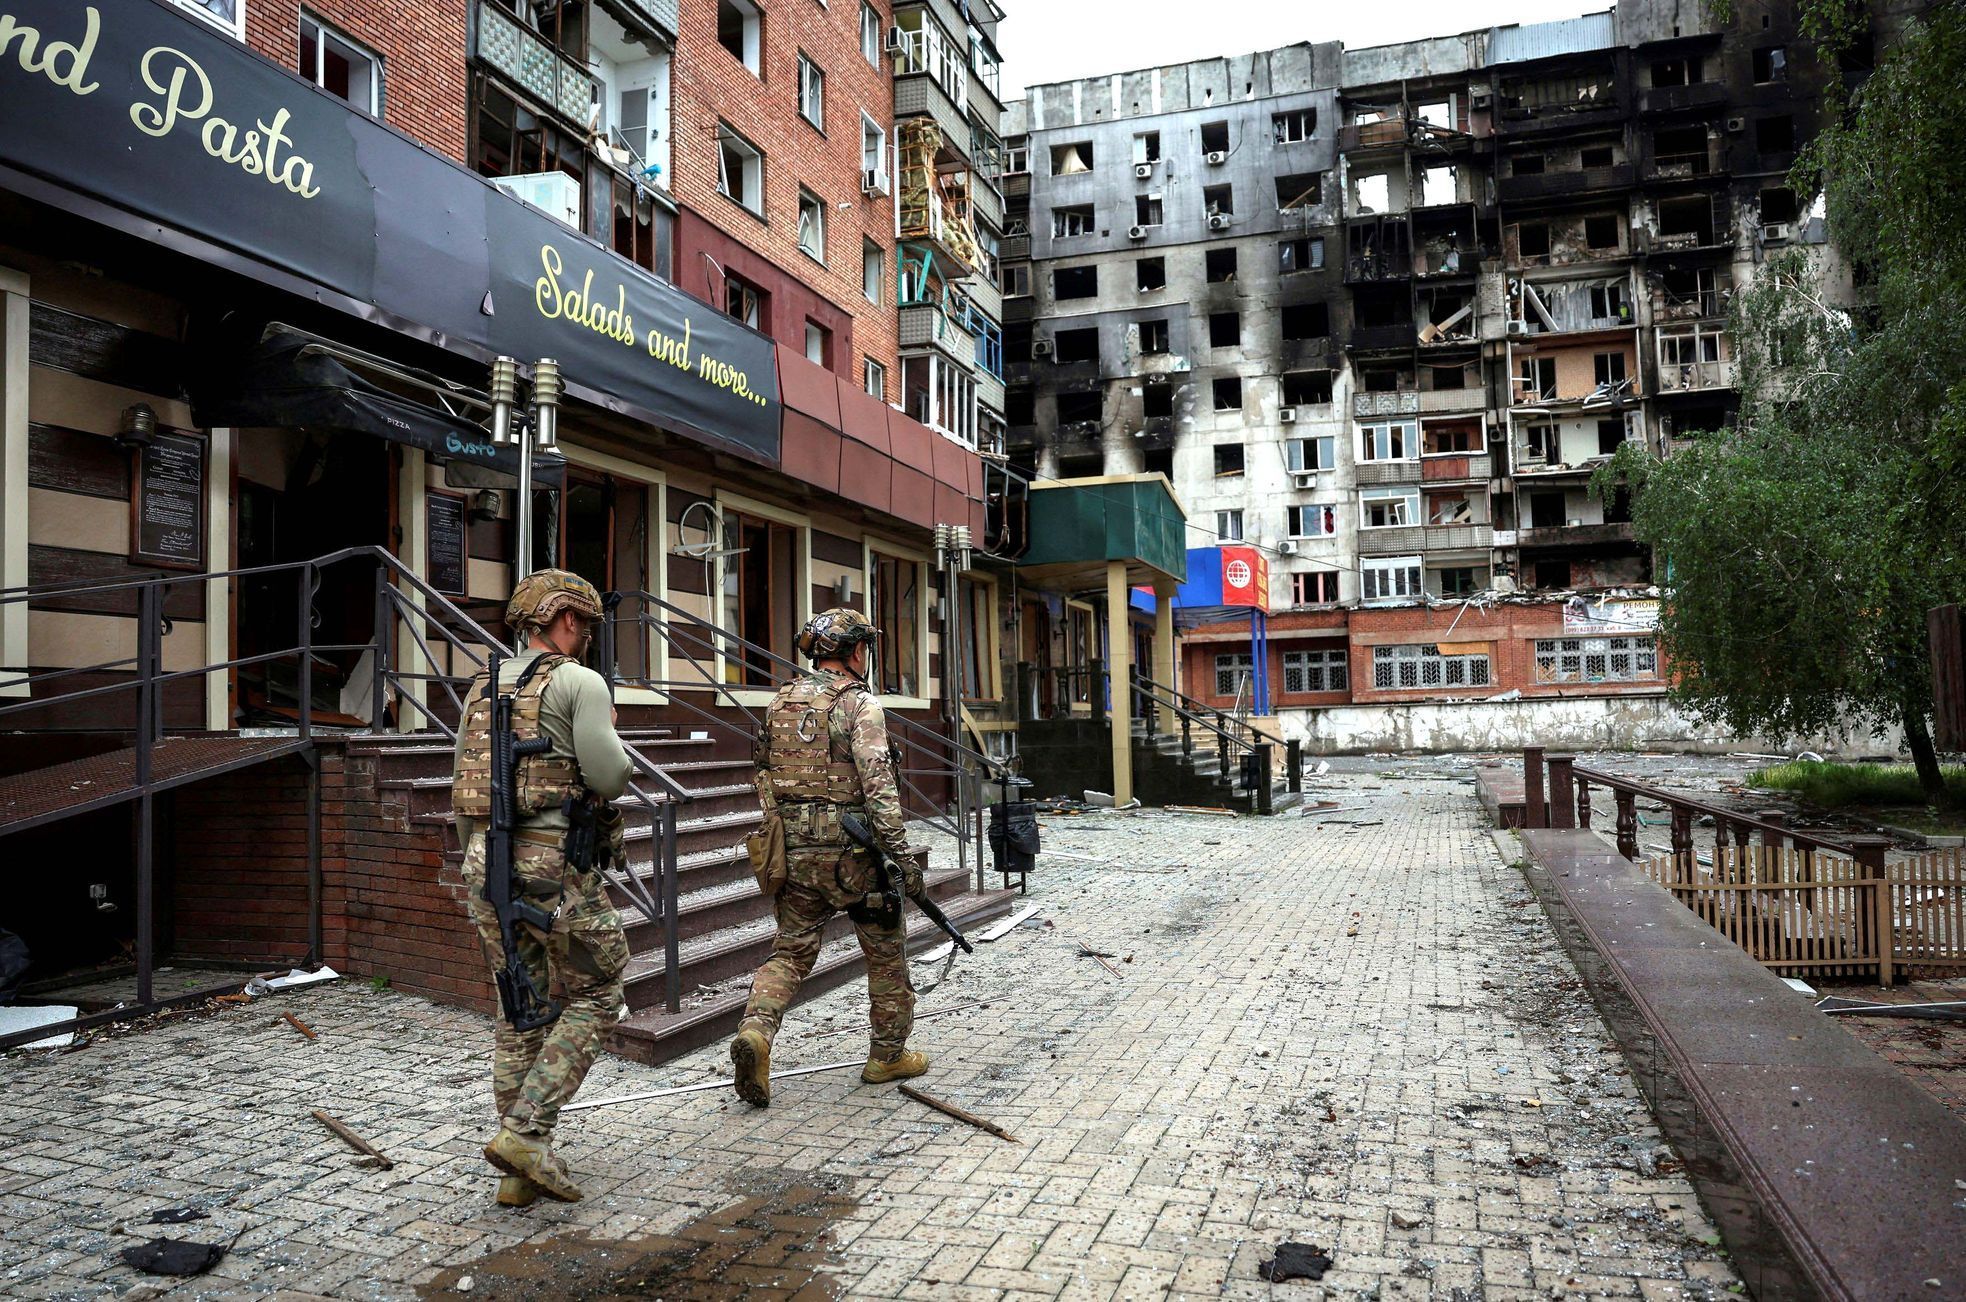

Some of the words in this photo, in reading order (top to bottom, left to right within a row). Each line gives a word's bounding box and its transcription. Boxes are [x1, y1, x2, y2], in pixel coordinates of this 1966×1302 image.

[129, 46, 321, 199] Pasta
[535, 244, 635, 347] Salads
[647, 318, 691, 371] and
[699, 353, 767, 406] more...
[387, 417, 411, 431] PIZZA
[446, 431, 496, 457] Gusto
